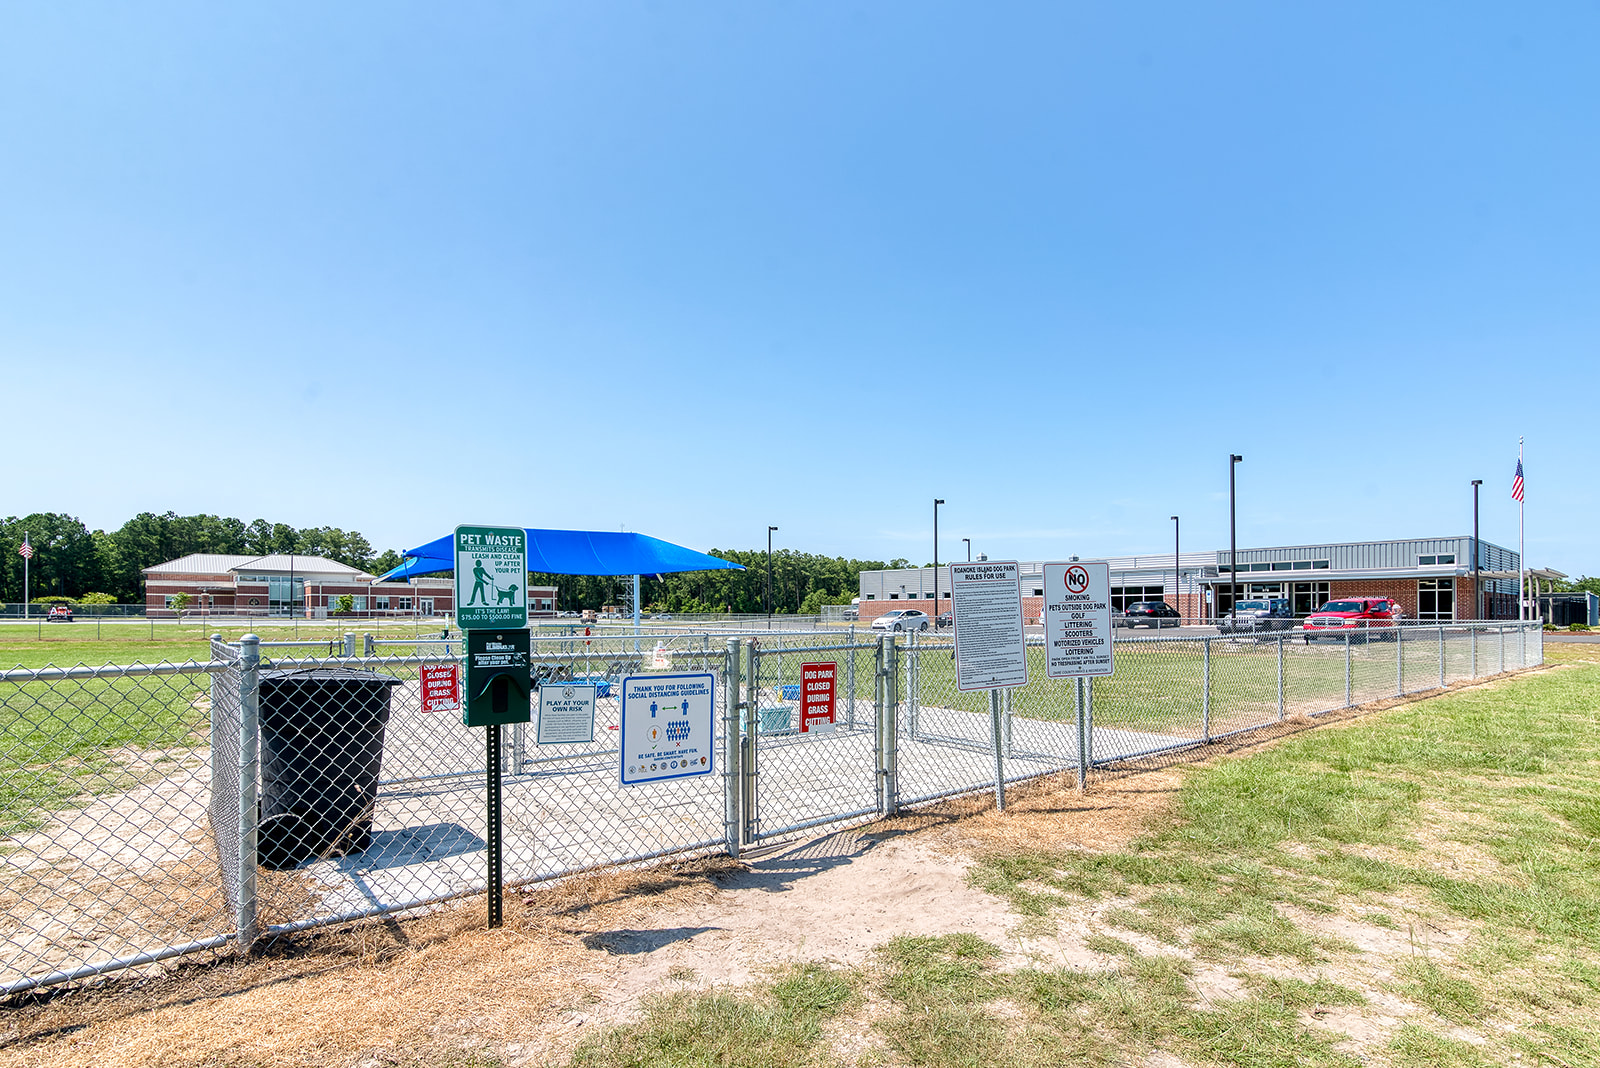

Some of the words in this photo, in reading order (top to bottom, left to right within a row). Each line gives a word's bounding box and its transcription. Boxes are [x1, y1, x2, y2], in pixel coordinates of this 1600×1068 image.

[460, 534, 482, 545] PET
[484, 534, 521, 546] WASTE
[1068, 574, 1085, 586] NO
[427, 671, 452, 679] CLOSED
[804, 671, 817, 679] DOG
[818, 670, 834, 678] PARK
[428, 680, 452, 688] DURING
[807, 682, 831, 691] CLOSED
[430, 689, 451, 697] GRASS
[648, 690, 680, 698] DISTANCING
[807, 693, 830, 703] DURING
[808, 705, 829, 714] GRASS
[805, 716, 831, 727] CUTTING
